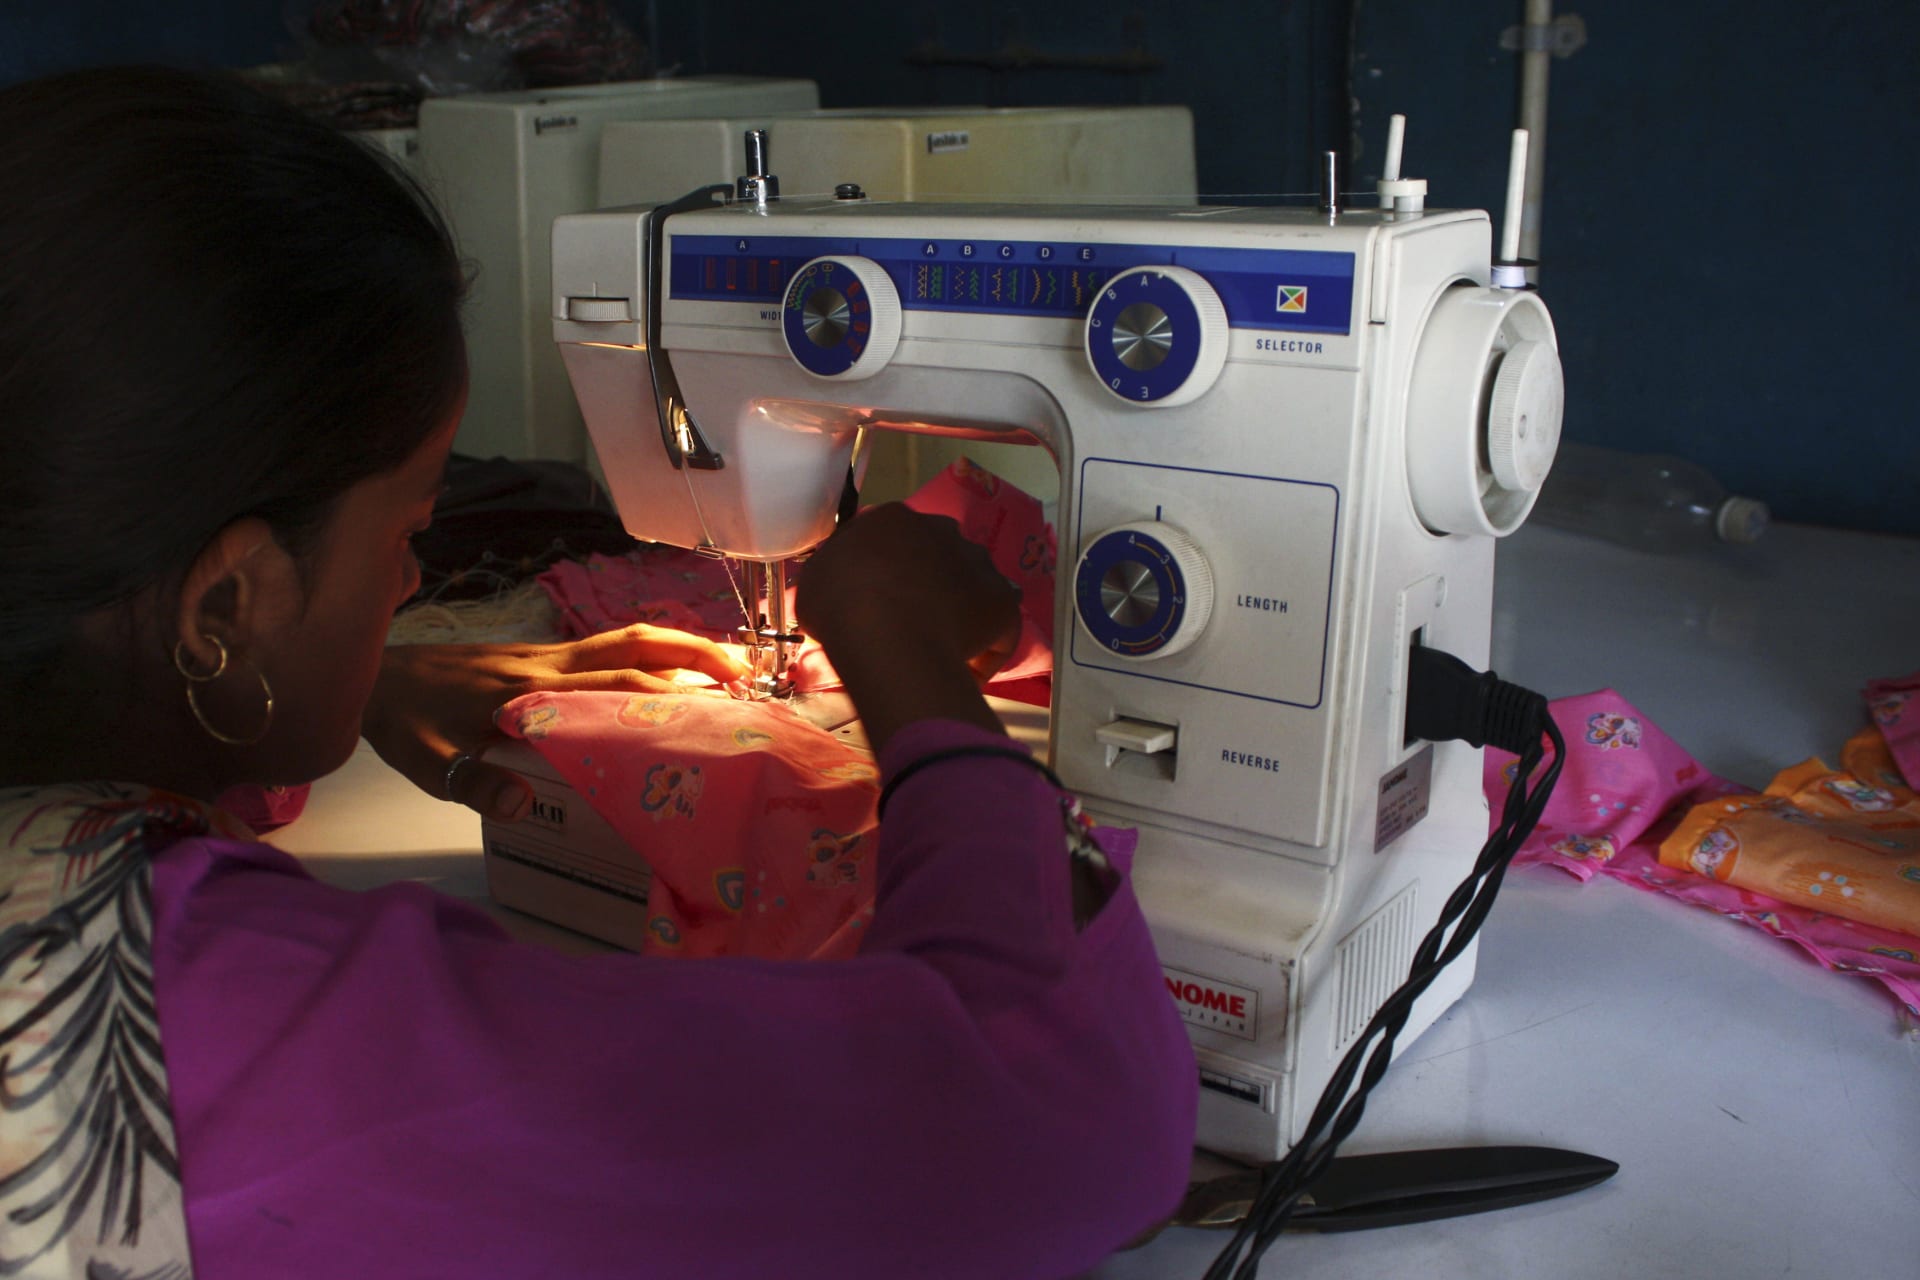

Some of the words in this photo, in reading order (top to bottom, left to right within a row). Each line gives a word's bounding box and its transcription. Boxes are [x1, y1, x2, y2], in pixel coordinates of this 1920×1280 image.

[737, 239, 746, 249] A
[926, 244, 935, 255] A
[963, 244, 972, 255] B
[1001, 245, 1010, 256] C
[1041, 247, 1050, 258] D
[1082, 248, 1091, 259] E
[1140, 275, 1149, 287] A
[1106, 288, 1117, 300] B
[1091, 318, 1102, 328] C
[1256, 338, 1323, 354] SELECTOR
[1111, 377, 1121, 389] D
[1140, 386, 1149, 399] E
[1128, 533, 1136, 545] 4
[1160, 553, 1171, 565] 3
[1172, 595, 1184, 604] 2
[1237, 593, 1288, 613] LENGTH
[1111, 637, 1120, 650] 0
[1222, 749, 1280, 772] REVERSE
